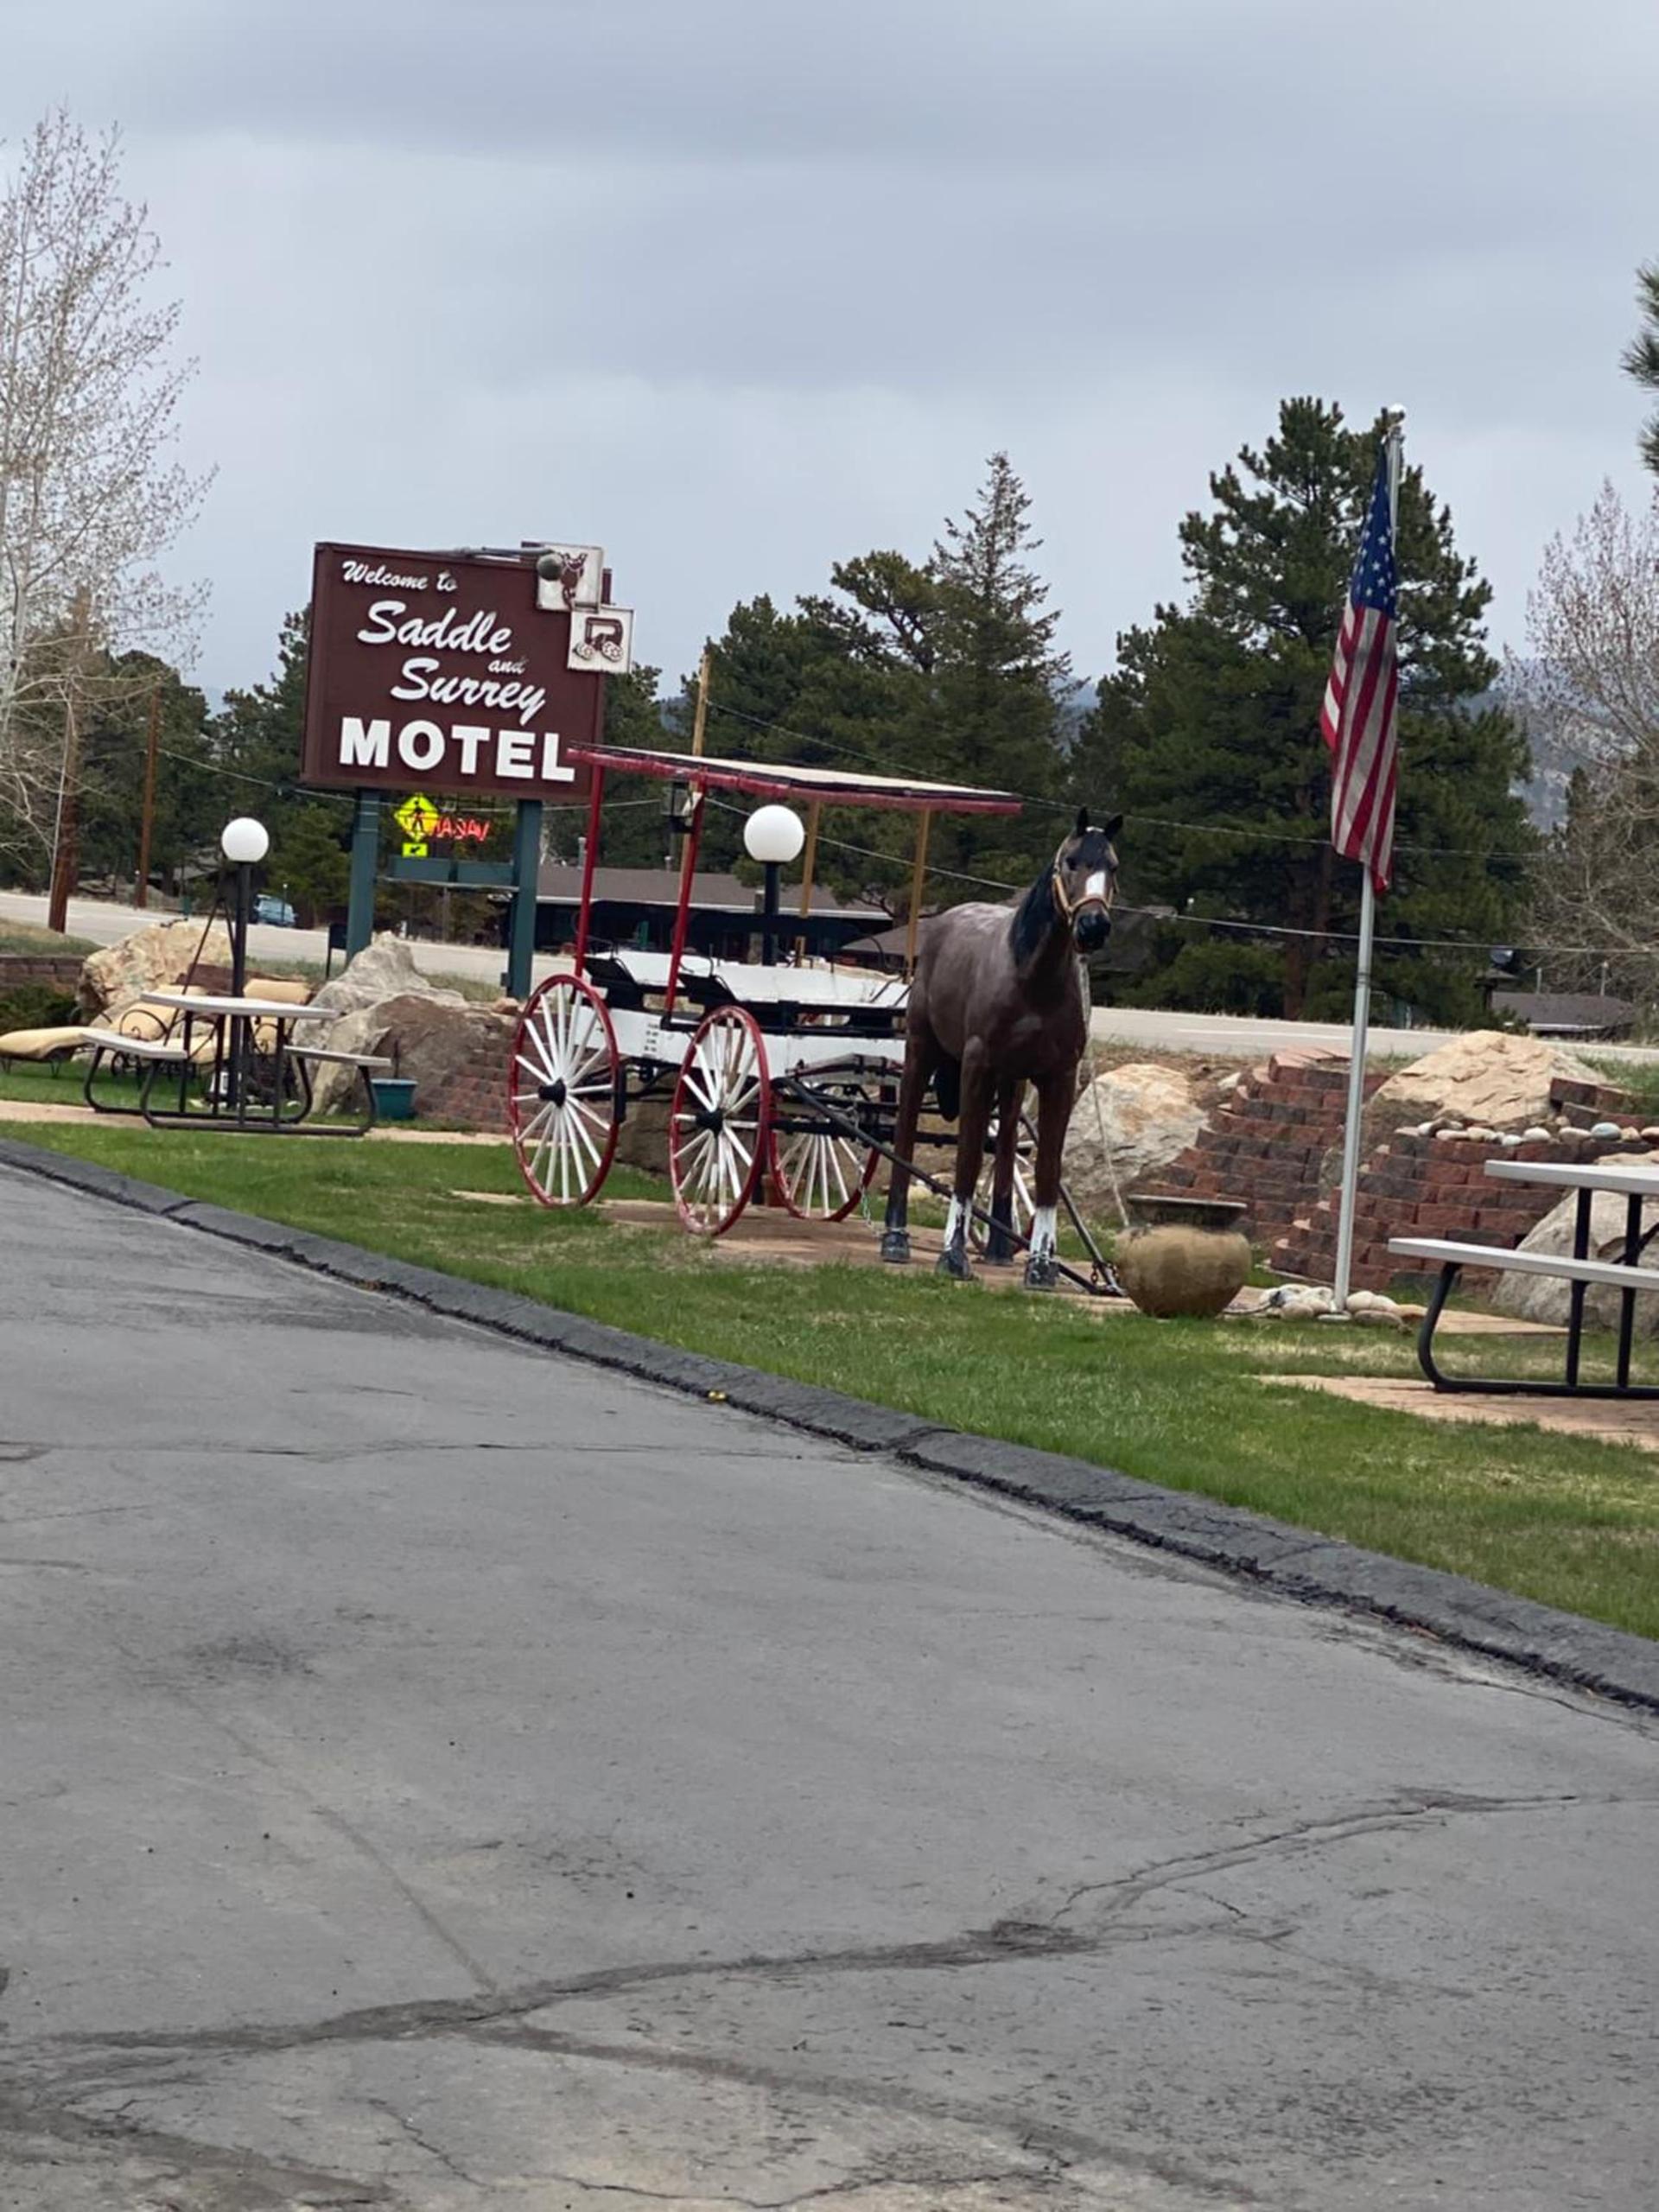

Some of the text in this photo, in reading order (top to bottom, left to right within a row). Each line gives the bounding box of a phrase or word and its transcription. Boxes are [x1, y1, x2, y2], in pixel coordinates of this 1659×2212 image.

[342, 560, 458, 592] Welcome to
[357, 600, 512, 654] Saddle
[391, 657, 546, 726] Surrey
[487, 655, 529, 674] and
[339, 716, 575, 782] MOTEL
